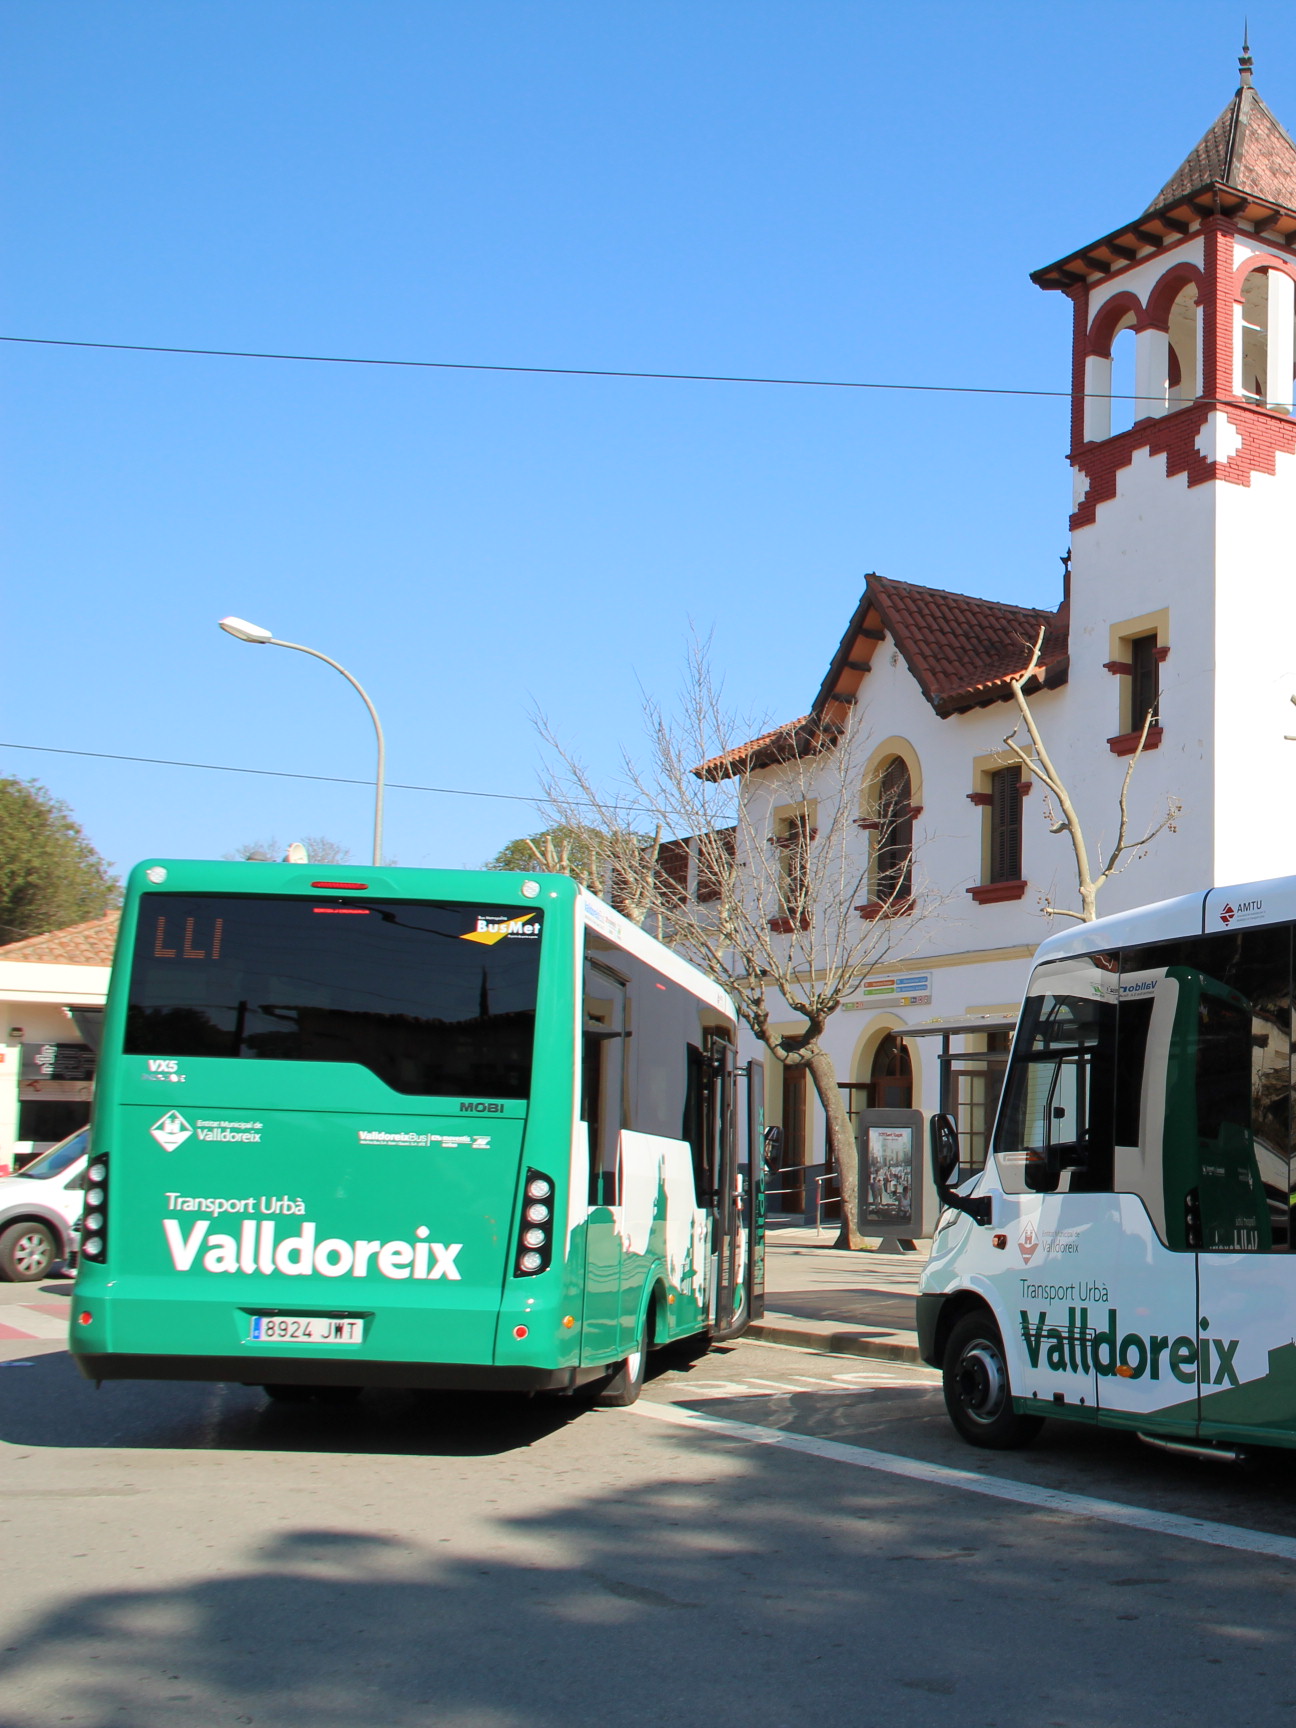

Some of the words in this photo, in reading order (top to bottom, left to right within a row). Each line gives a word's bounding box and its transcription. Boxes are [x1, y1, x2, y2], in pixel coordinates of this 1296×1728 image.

[1236, 900, 1263, 913] AMTU
[476, 919, 541, 934] BusMet
[148, 1059, 179, 1072] VX5
[459, 1102, 505, 1113] MOBI
[220, 1120, 253, 1130] Municipal
[253, 1121, 264, 1129] de
[196, 1128, 262, 1143] Valldoreix
[164, 1192, 257, 1217] Transport
[259, 1194, 306, 1215] Urbà
[162, 1218, 464, 1280] Valldoreix
[1042, 1239, 1079, 1254] Valldoreix
[1019, 1278, 1075, 1306] Transport
[1078, 1280, 1109, 1303] Urbà
[265, 1320, 313, 1338] 8924
[321, 1321, 358, 1340] JWT
[1019, 1306, 1240, 1387] Valldoreix
